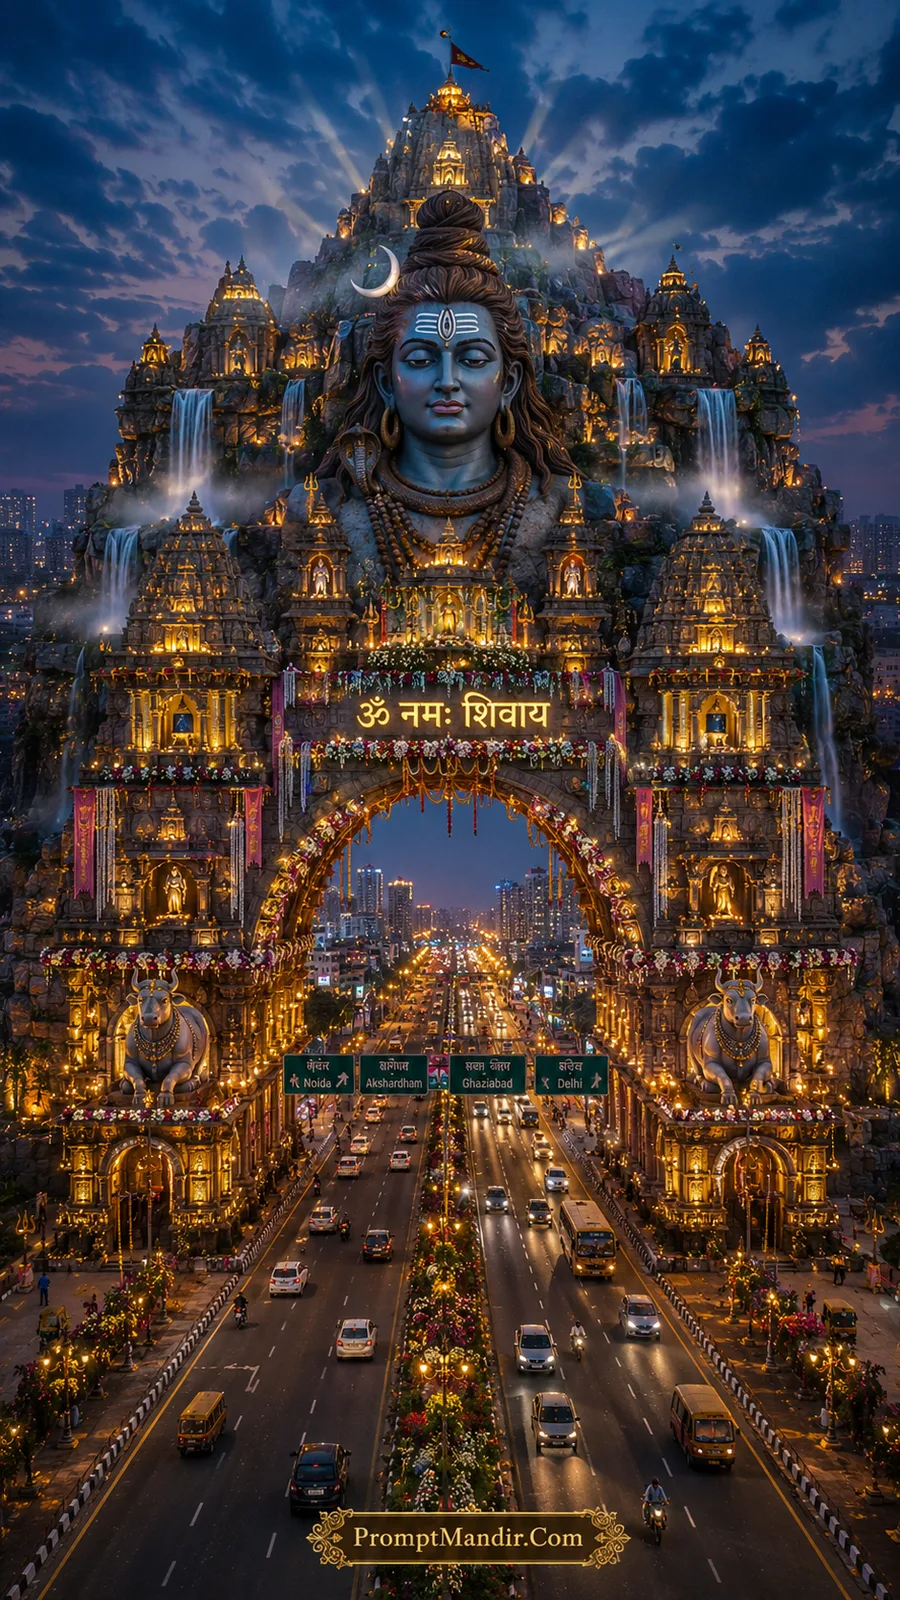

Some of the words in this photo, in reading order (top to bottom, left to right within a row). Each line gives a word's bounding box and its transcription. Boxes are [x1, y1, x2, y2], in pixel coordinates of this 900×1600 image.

[356, 695, 390, 728] ॐ
[398, 702, 452, 728] नमः
[461, 691, 551, 728] शिवाय
[303, 1077, 332, 1088] Noida
[365, 1077, 423, 1088] Akshardham
[462, 1077, 513, 1089] Ghaziabad
[557, 1077, 583, 1089] Delhi
